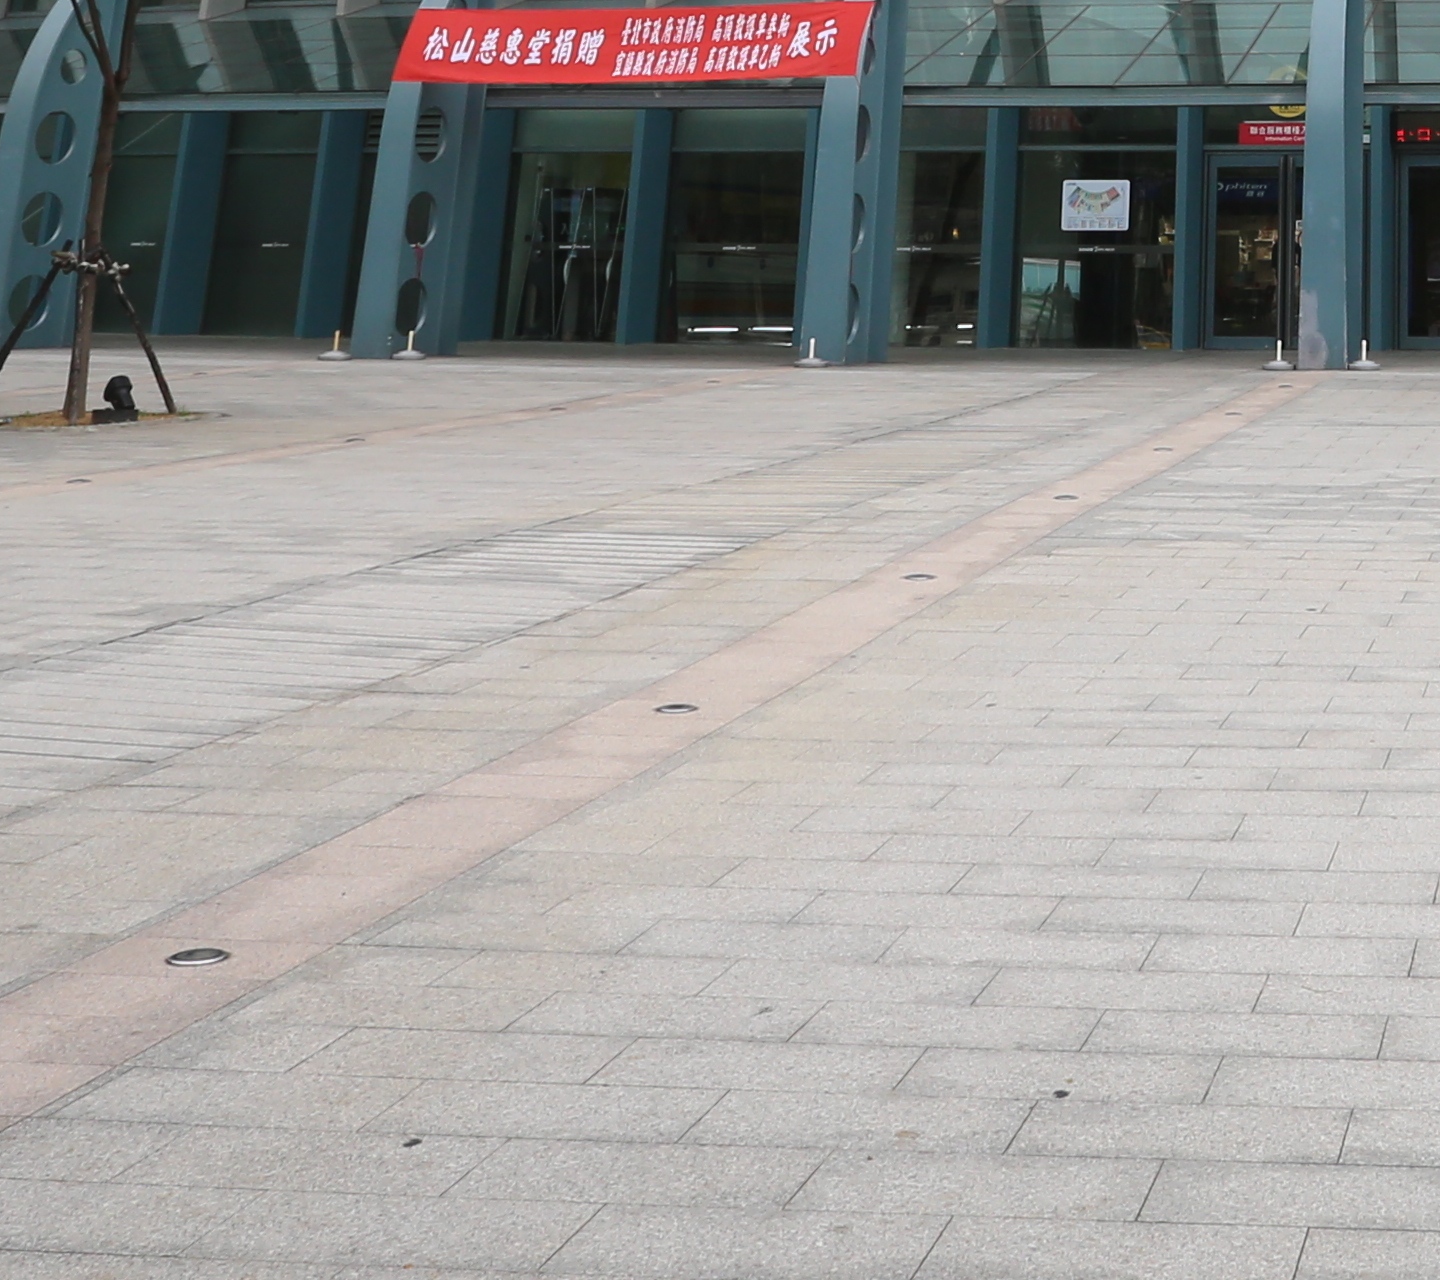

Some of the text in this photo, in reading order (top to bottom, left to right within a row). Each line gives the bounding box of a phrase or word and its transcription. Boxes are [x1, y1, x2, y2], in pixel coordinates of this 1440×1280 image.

[422, 25, 606, 66] 松山慈惠堂捐贈
[786, 18, 839, 59] 展示
[1224, 181, 1268, 192] phiten
